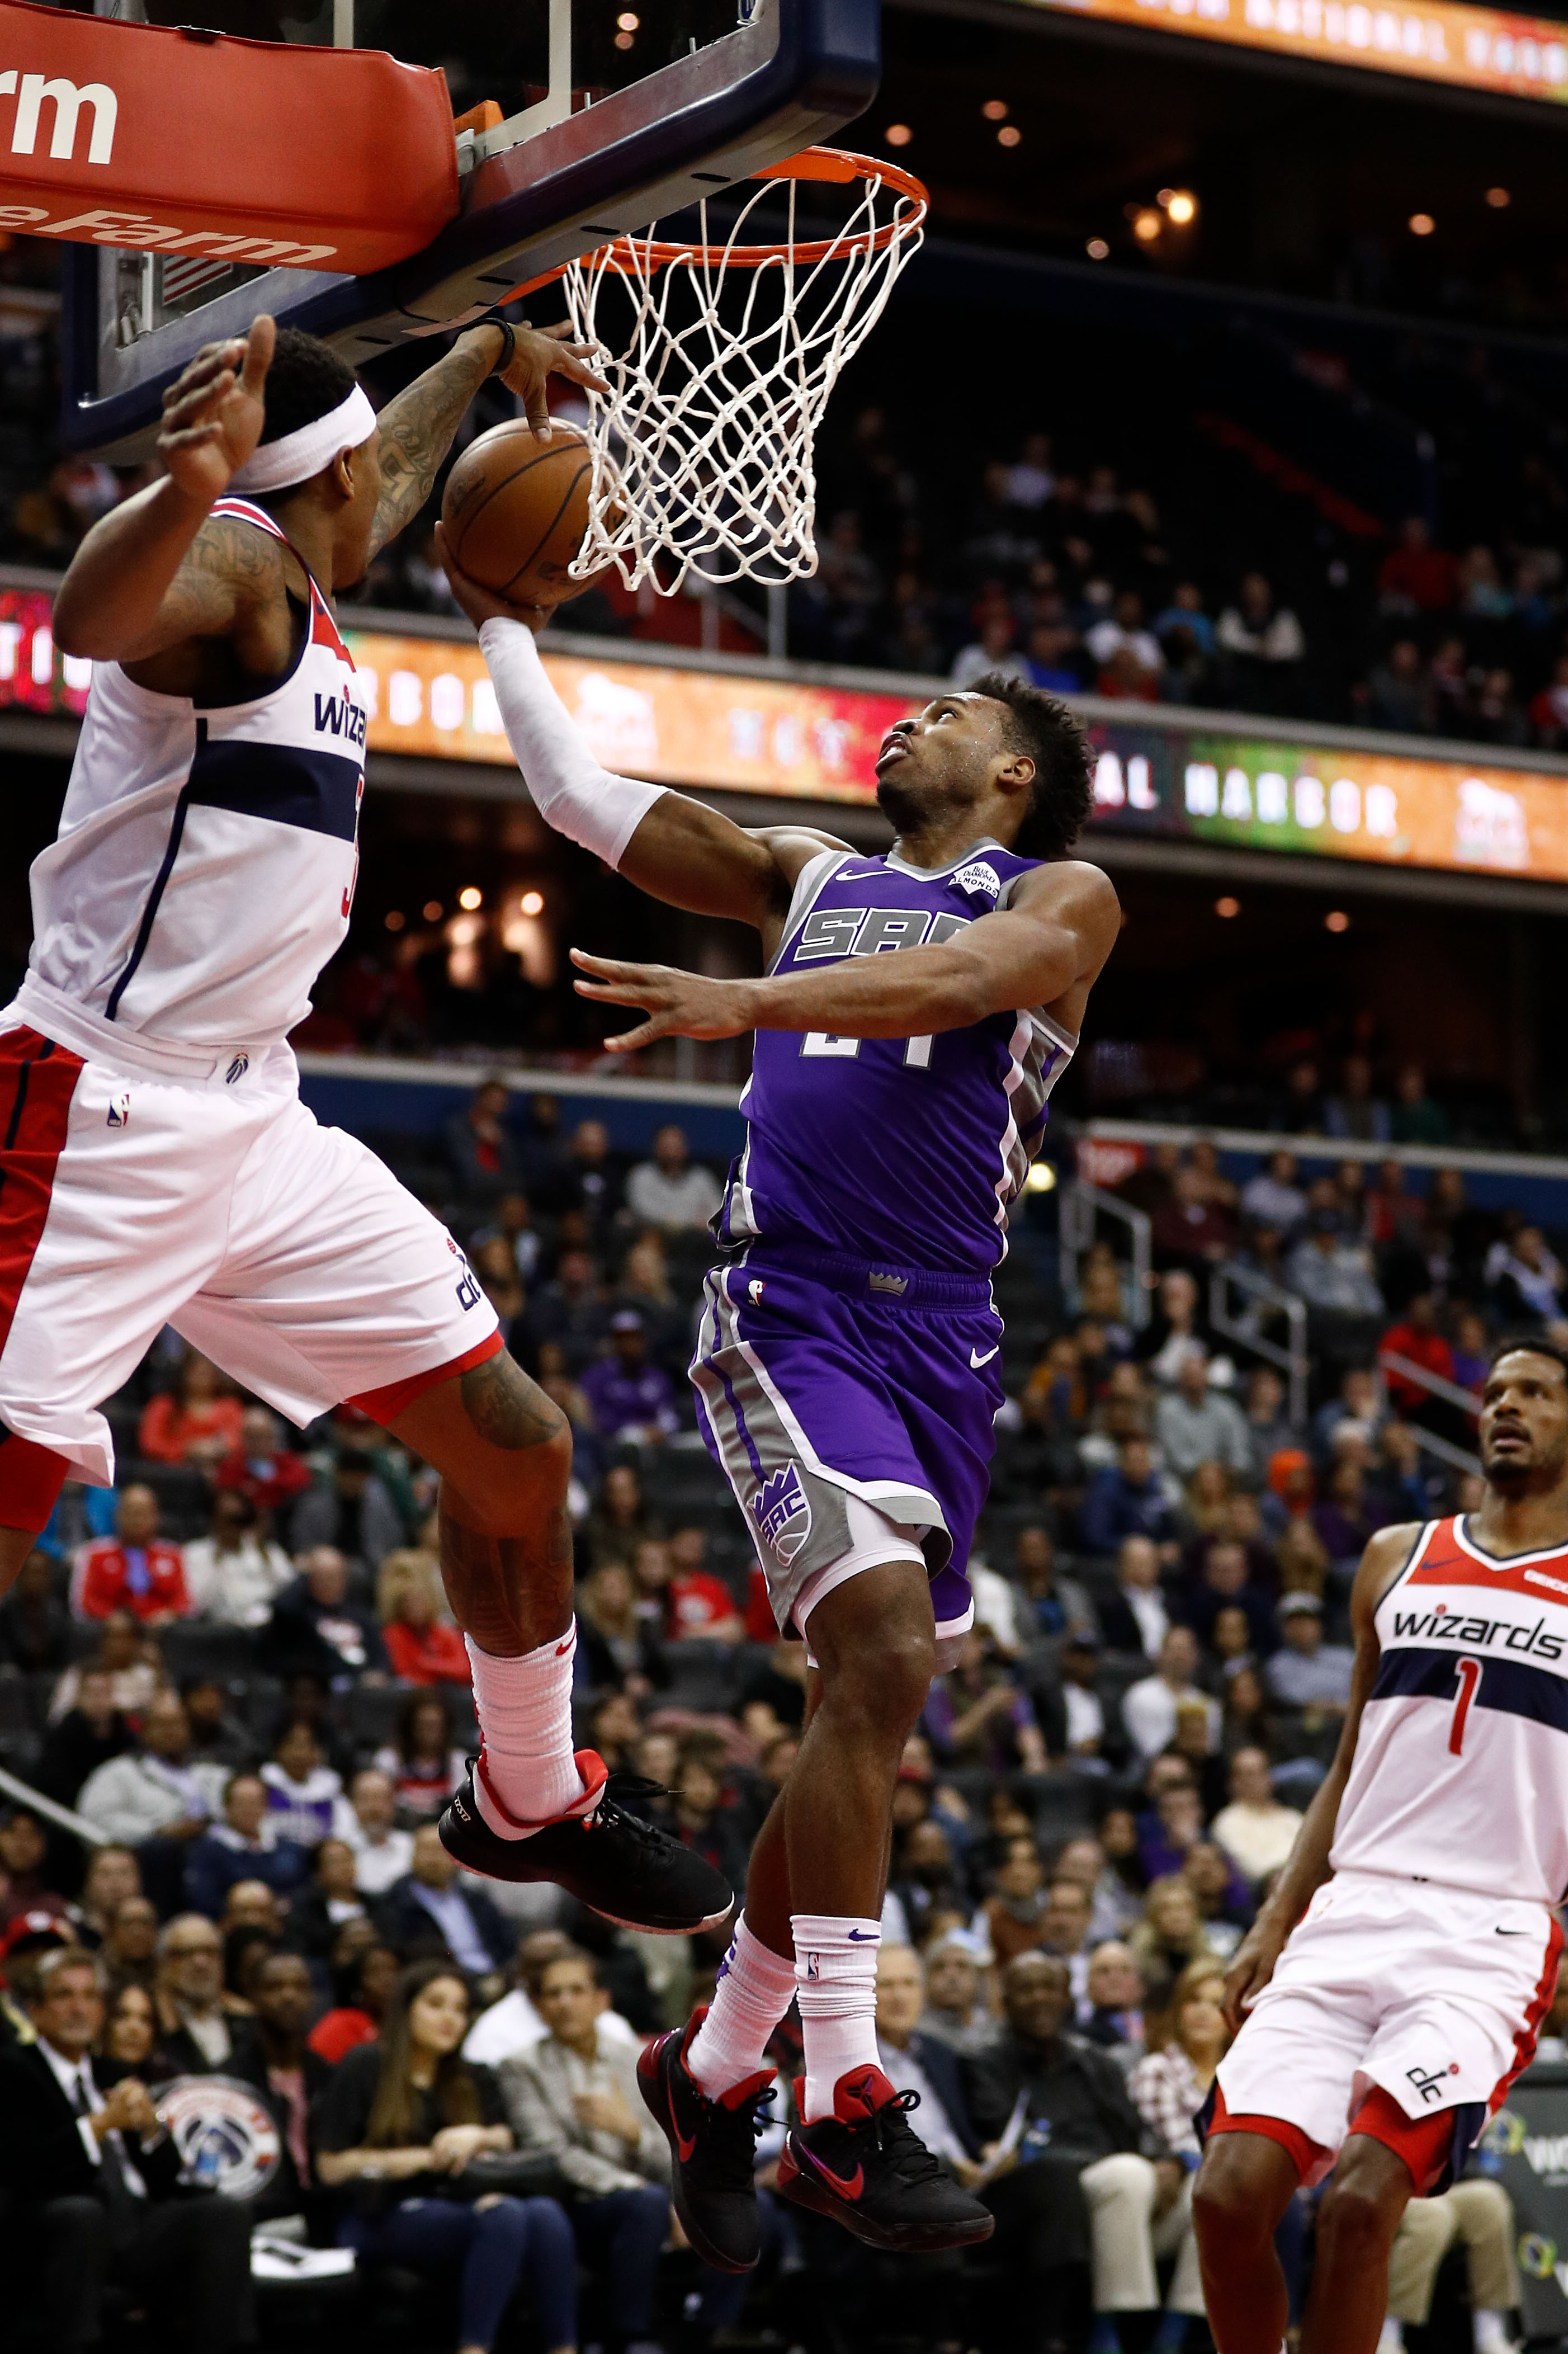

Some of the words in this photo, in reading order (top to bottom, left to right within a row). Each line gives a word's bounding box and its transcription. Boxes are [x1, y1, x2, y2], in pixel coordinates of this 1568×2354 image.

[34, 210, 337, 263] Farm
[951, 877, 996, 896] ALMONDS
[963, 870, 995, 883] DIAMOND
[973, 866, 989, 874] BLUE
[1394, 1603, 1568, 1660] wizards
[1448, 1657, 1483, 1756] 1
